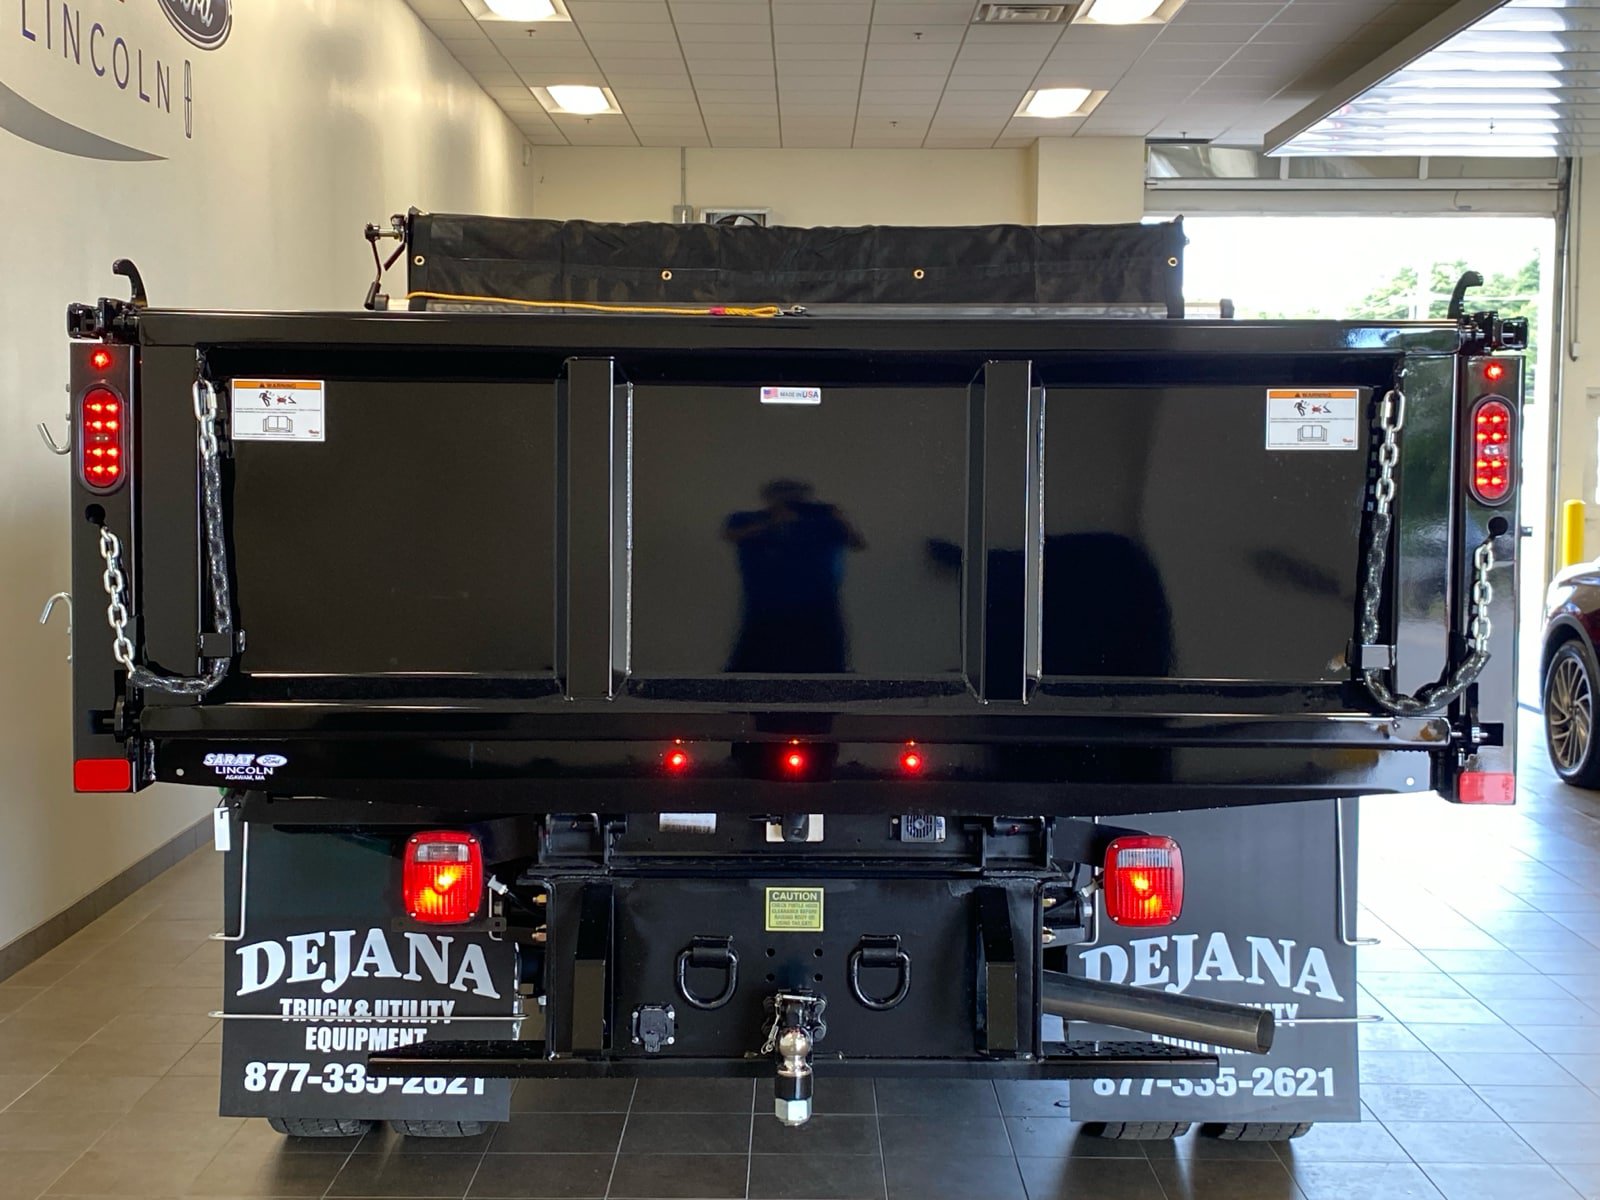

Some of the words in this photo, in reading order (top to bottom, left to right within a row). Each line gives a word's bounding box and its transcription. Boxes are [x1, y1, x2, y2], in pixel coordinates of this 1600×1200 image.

[21, 0, 171, 114] LINCOLN
[203, 753, 255, 766] SARAT
[215, 766, 273, 775] LINCOLN
[772, 892, 817, 901] CAUTION
[235, 928, 501, 999] DEJANA
[1079, 932, 1344, 1002] DEJANA
[280, 998, 352, 1022] TRUCK
[374, 1000, 455, 1024] UTILITY
[305, 1027, 427, 1052] EQUIPMENT
